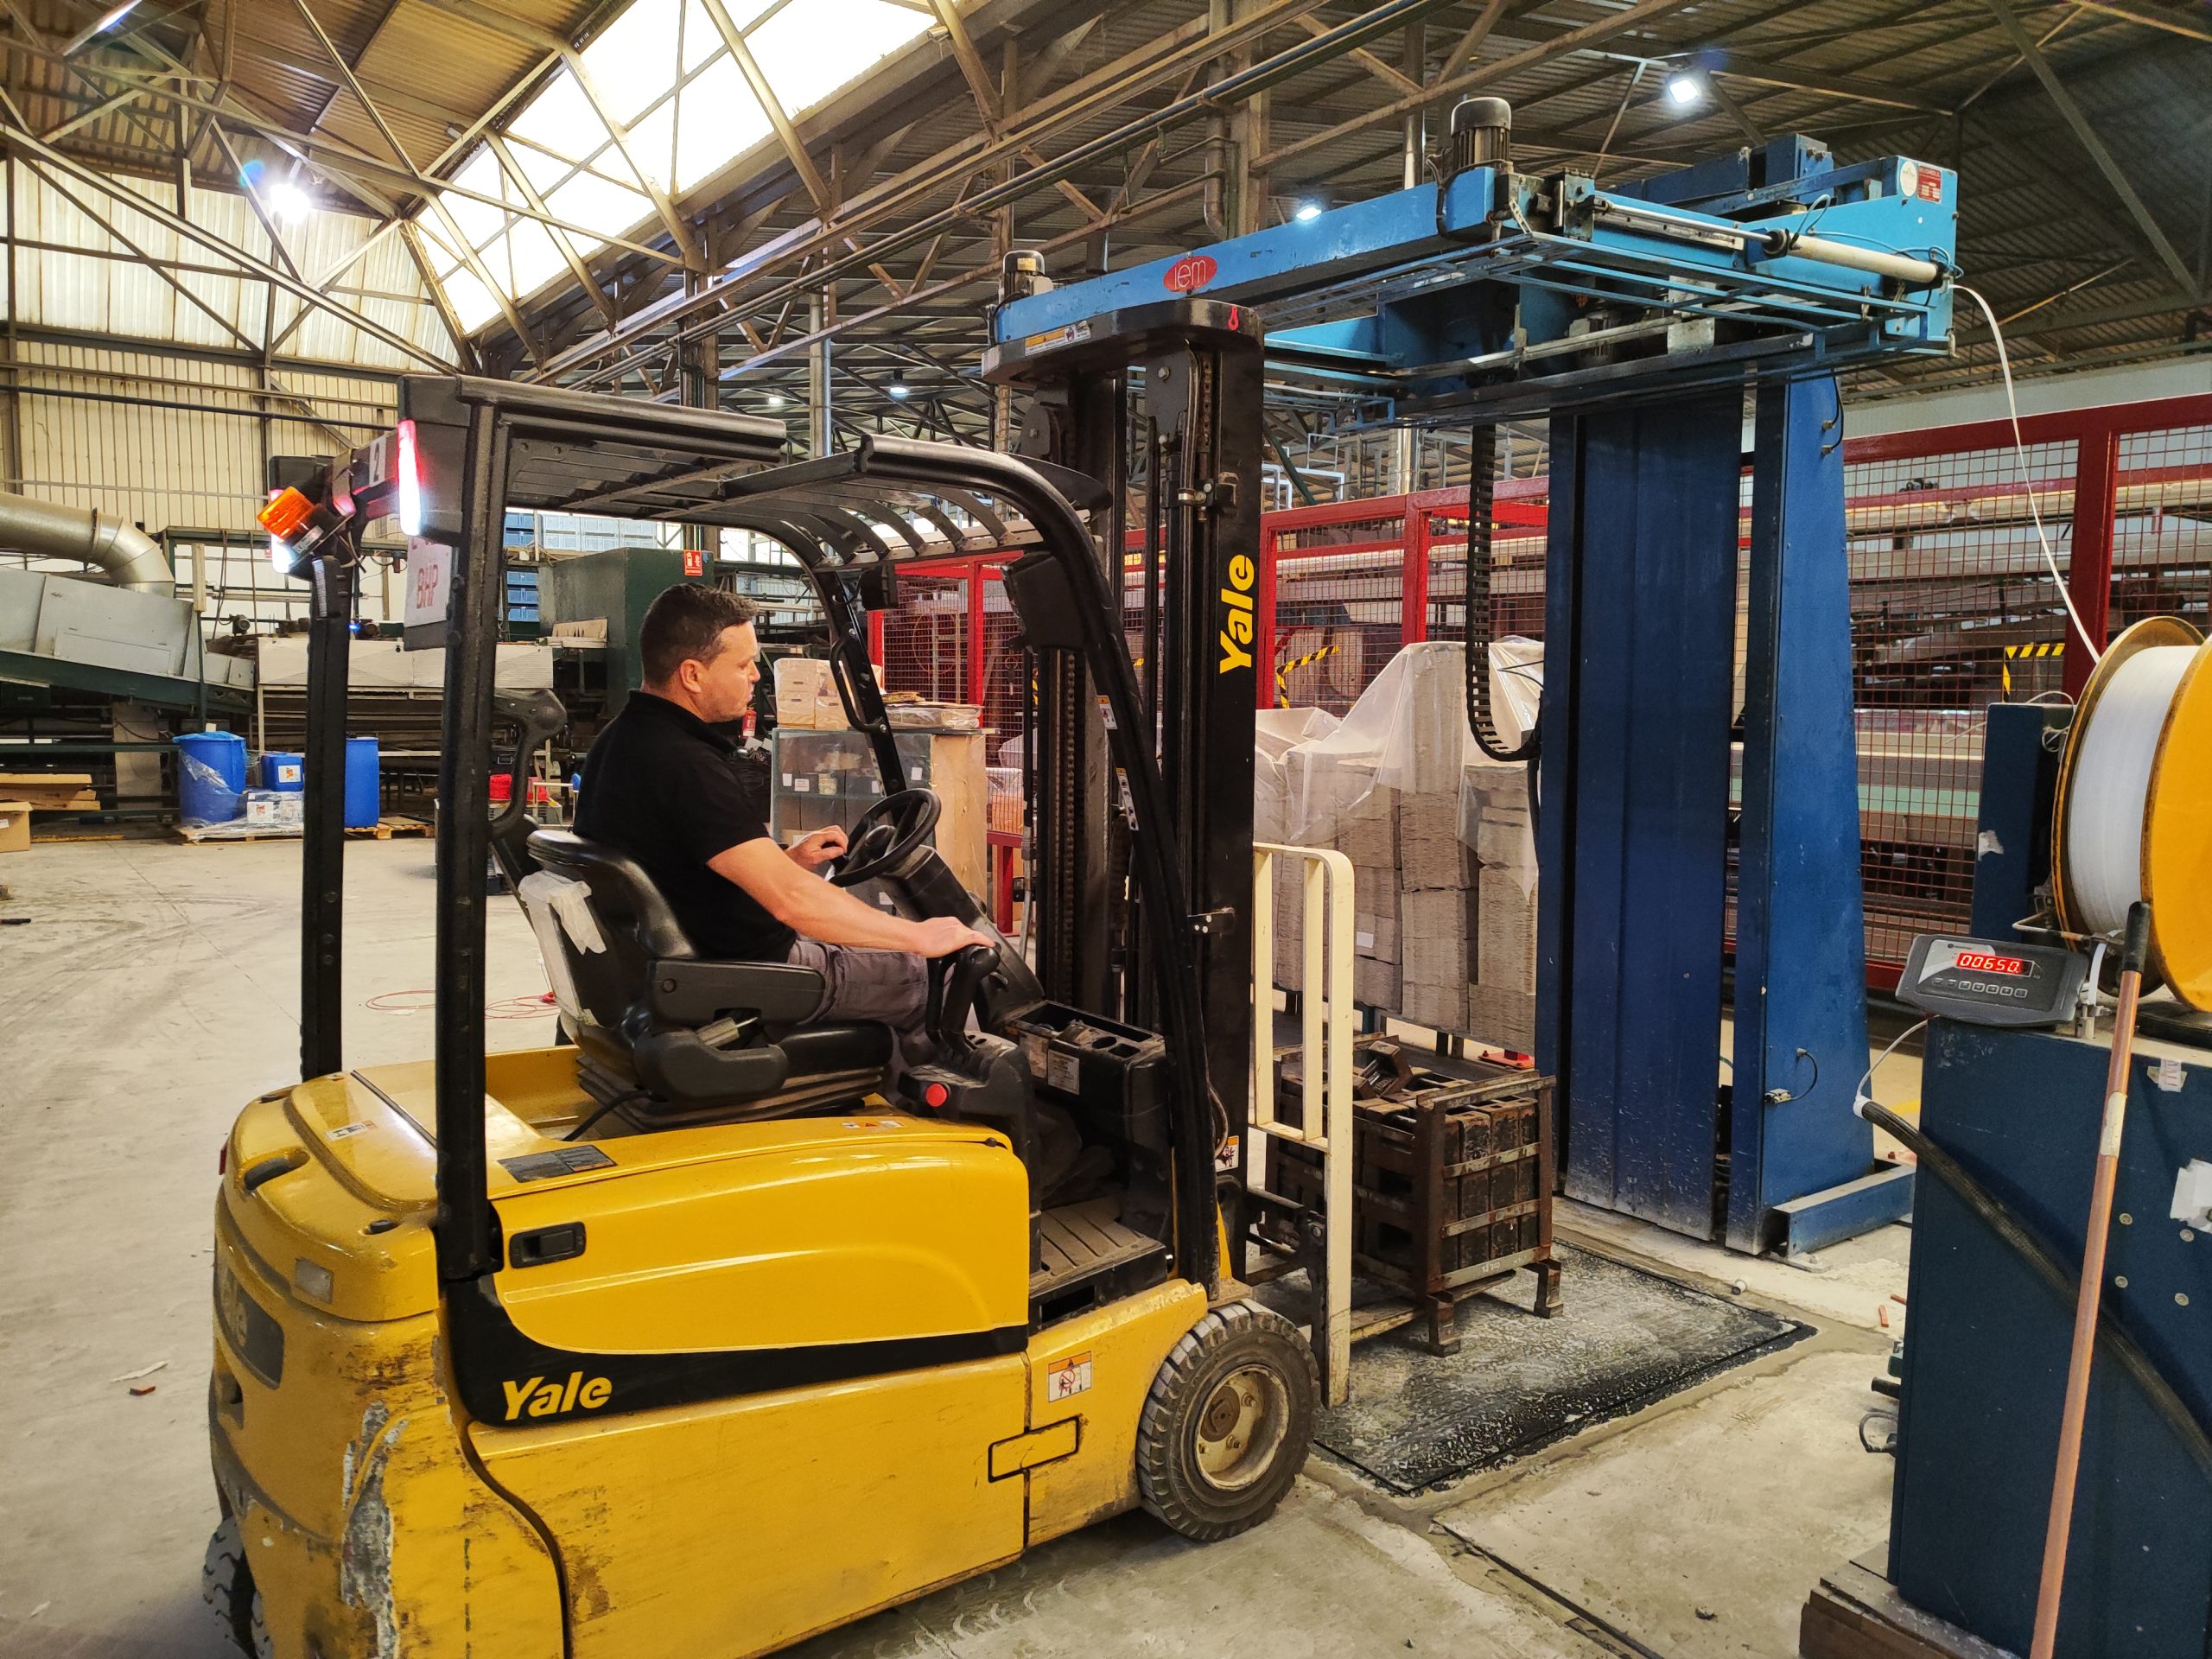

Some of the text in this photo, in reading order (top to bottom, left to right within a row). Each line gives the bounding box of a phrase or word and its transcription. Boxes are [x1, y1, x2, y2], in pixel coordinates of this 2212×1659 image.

[372, 442, 380, 482] 2
[1219, 554, 1255, 674] Yale
[502, 1371, 613, 1421] Yale
